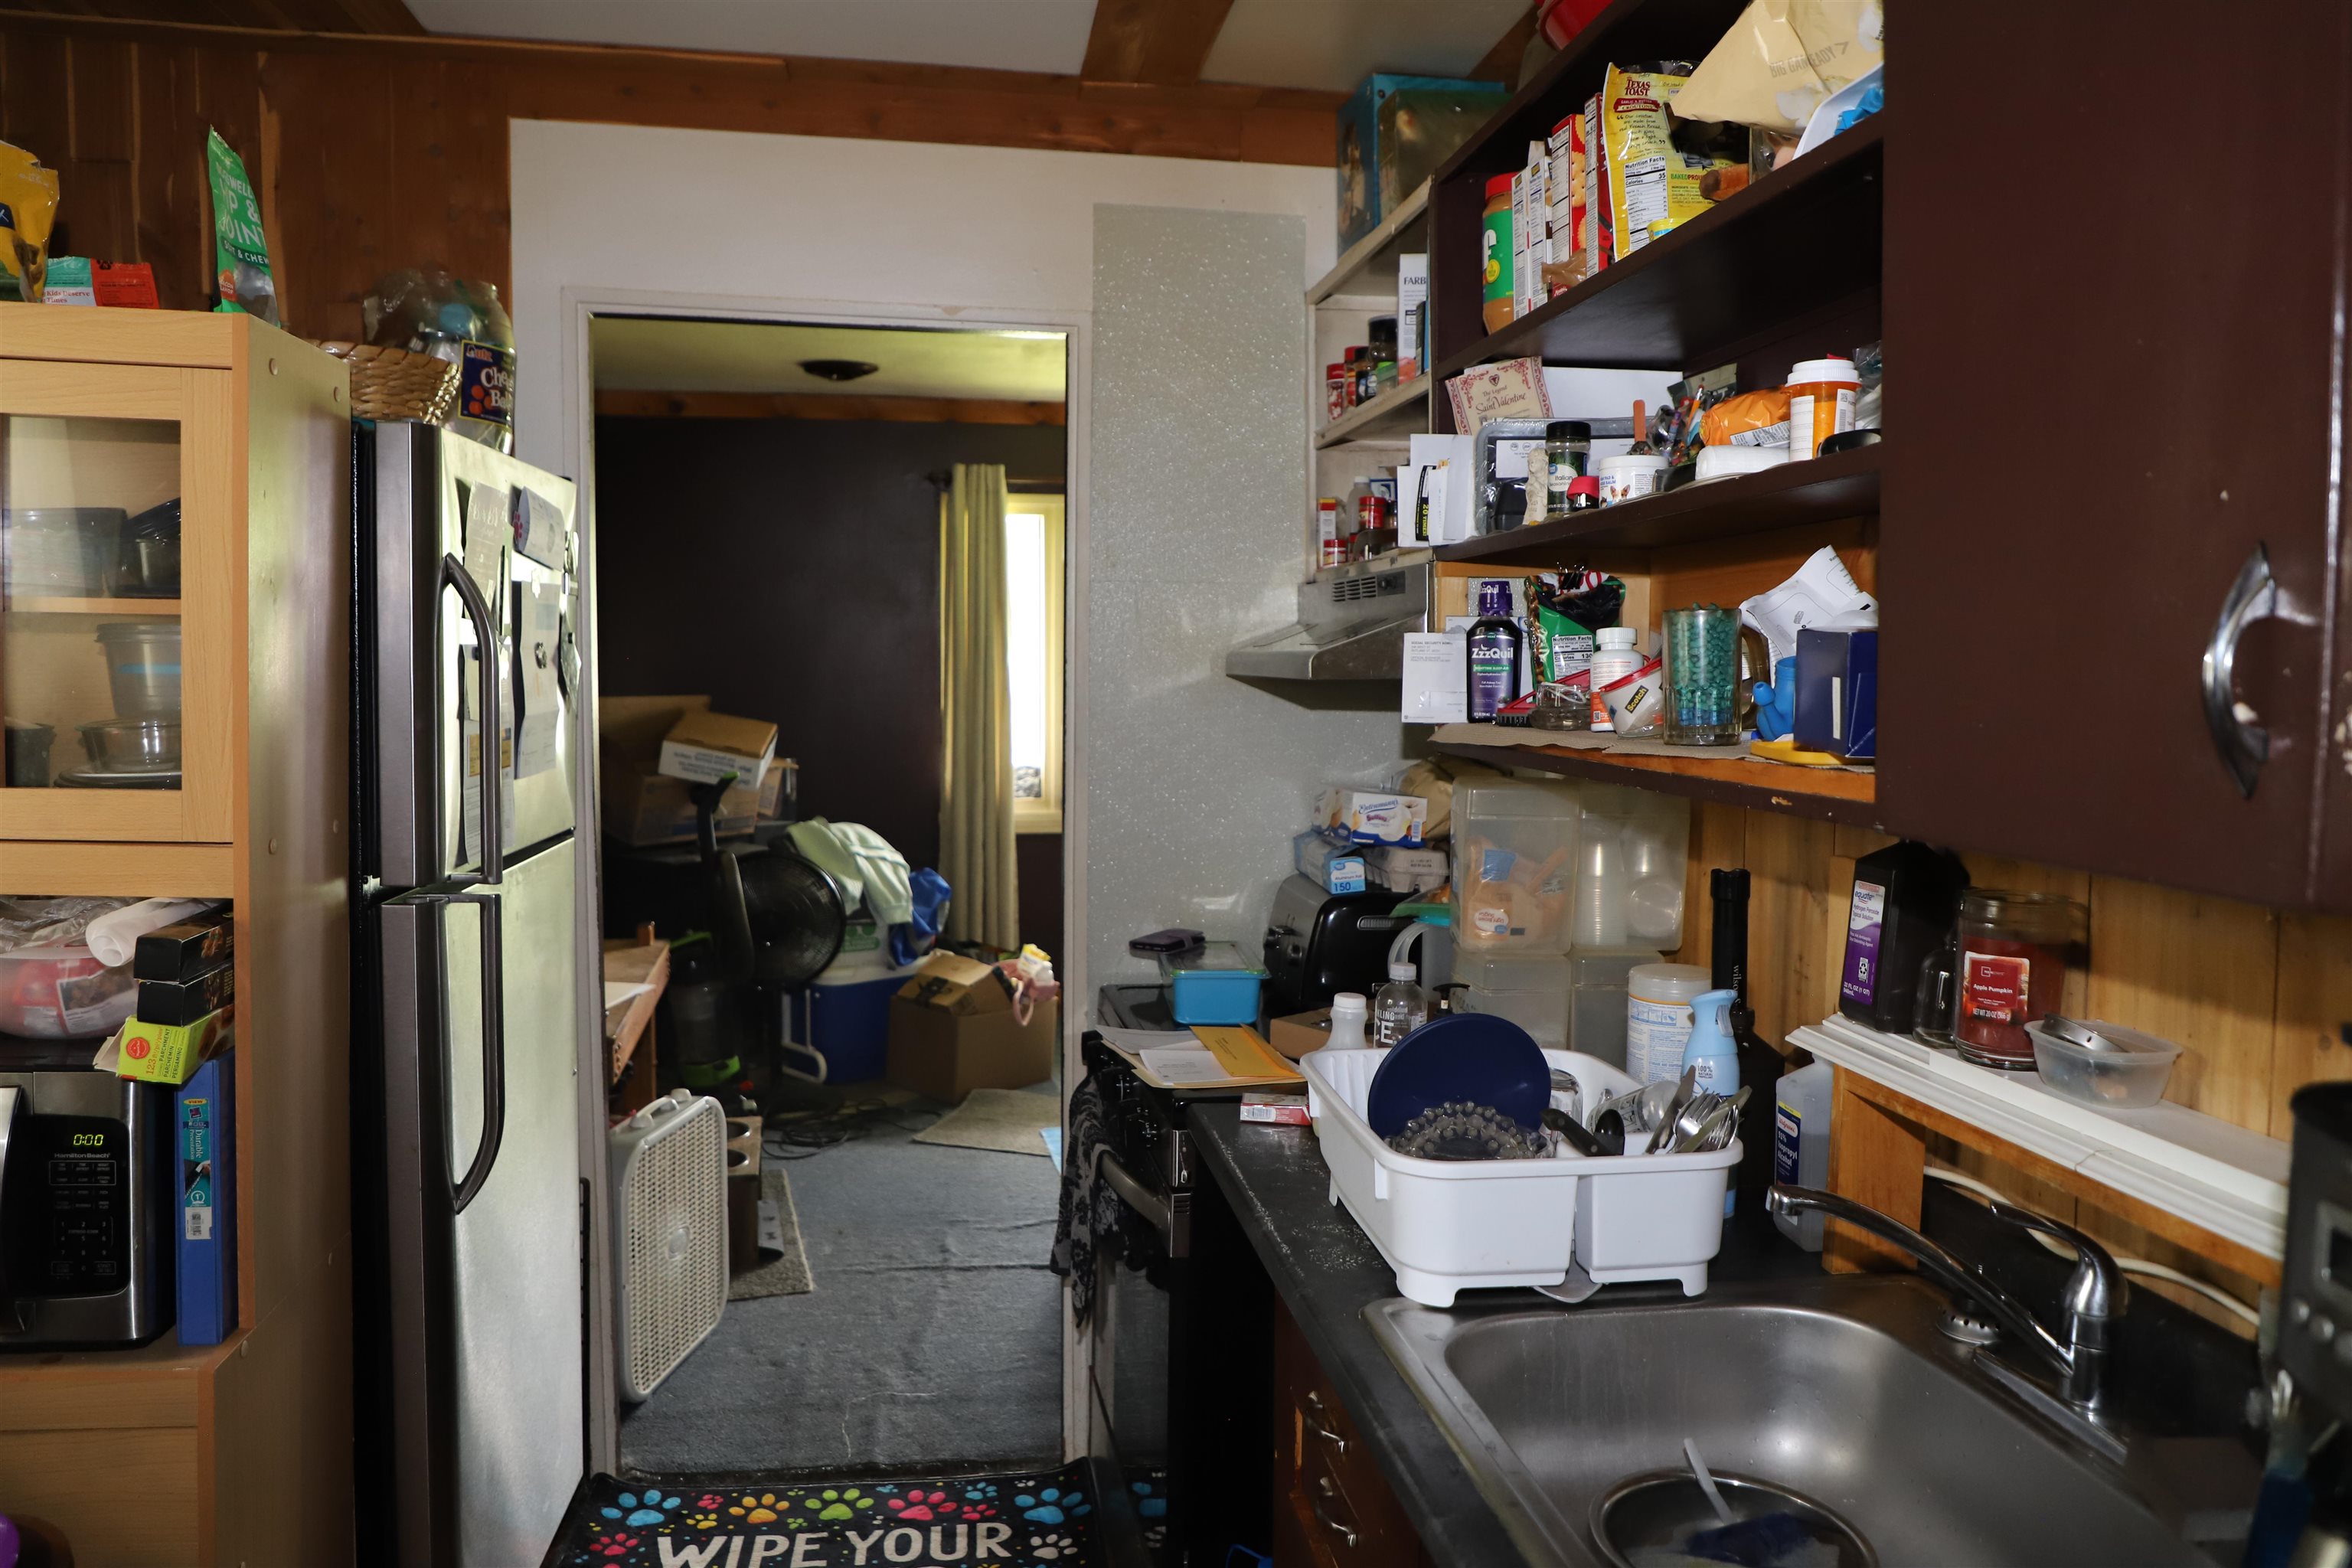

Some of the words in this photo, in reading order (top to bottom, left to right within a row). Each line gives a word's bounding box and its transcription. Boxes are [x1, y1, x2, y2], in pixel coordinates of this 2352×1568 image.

[1770, 62, 1786, 77] BIG
[1626, 79, 1651, 89] TEXAS
[1625, 88, 1650, 96] TOAST
[1625, 159, 1650, 169] Nutrition
[246, 199, 260, 224] &
[237, 249, 243, 259] &
[1491, 384, 1508, 394] Legend
[1475, 402, 1495, 415] Saint
[1492, 392, 1526, 408] Valentine
[1423, 504, 1429, 514] 20
[1472, 647, 1514, 660] ZzzQuil
[1627, 688, 1647, 712] Scotch
[1334, 882, 1351, 892] 150
[1855, 890, 1873, 901] equate
[1733, 965, 1742, 991] wilso
[1973, 983, 1988, 991] Apple
[1988, 985, 2013, 994] Pumpkin
[159, 1028, 171, 1062] PARCHMENT
[146, 1058, 157, 1075] 123
[164, 1045, 175, 1077] PARCHEMIN
[172, 1047, 183, 1079] PERGAMINO
[74, 1134, 103, 1145] 0:00
[195, 1129, 204, 1158] Durable
[1778, 1151, 1792, 1167] Alcohol
[657, 1531, 829, 1568] WIPE
[845, 1522, 1012, 1566] YOUR
